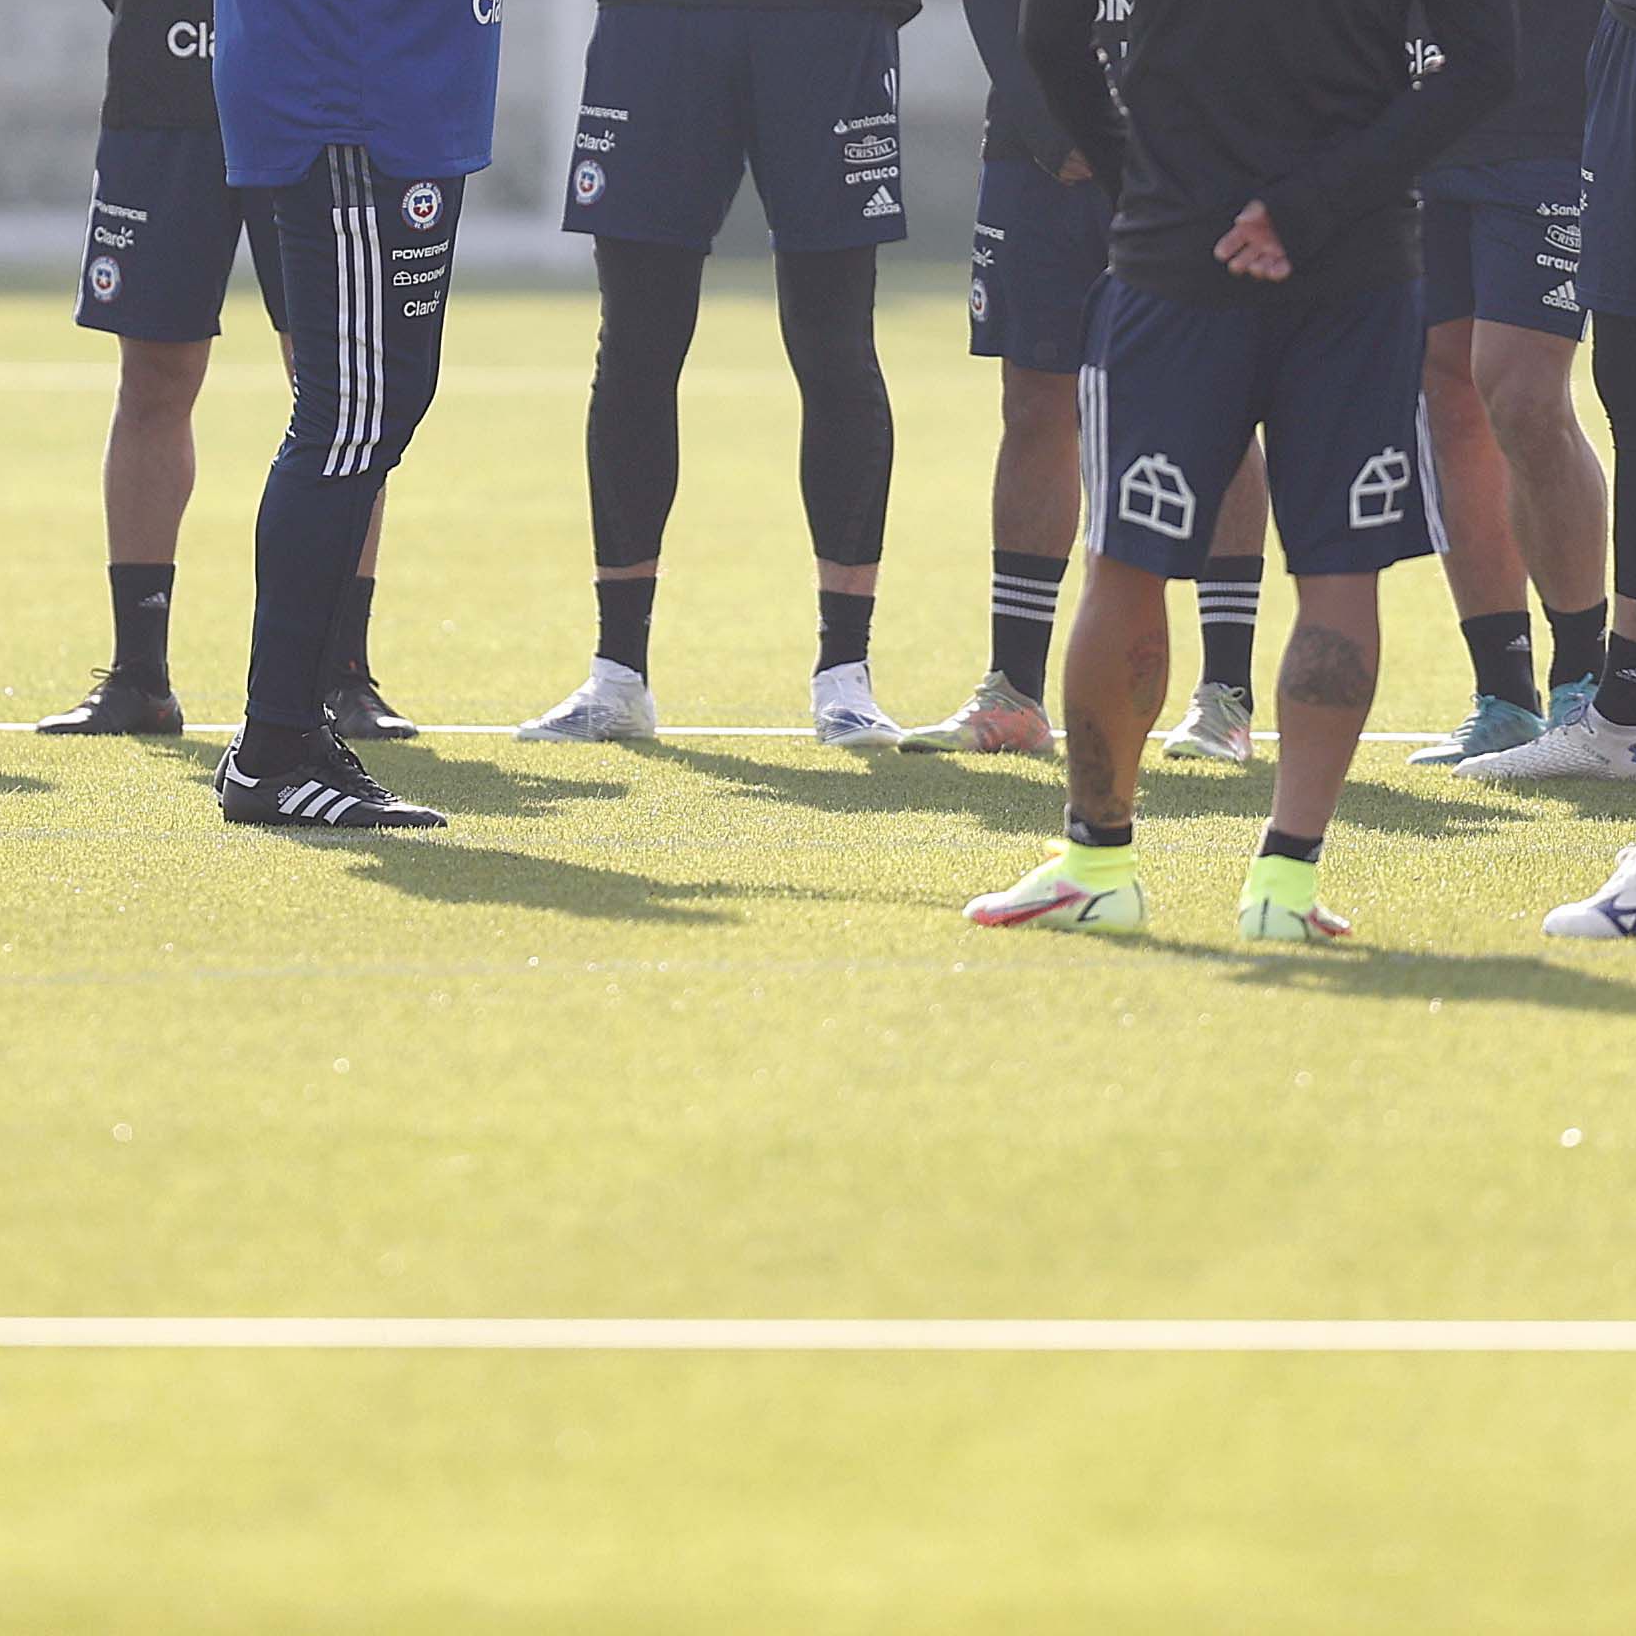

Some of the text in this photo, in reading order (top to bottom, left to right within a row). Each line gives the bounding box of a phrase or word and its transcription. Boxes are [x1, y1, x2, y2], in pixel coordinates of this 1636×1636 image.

[576, 132, 610, 152] Claro
[848, 143, 892, 159] CRISTAL
[845, 166, 898, 184] arauco
[94, 226, 126, 249] Claro
[403, 299, 437, 317] Claro
